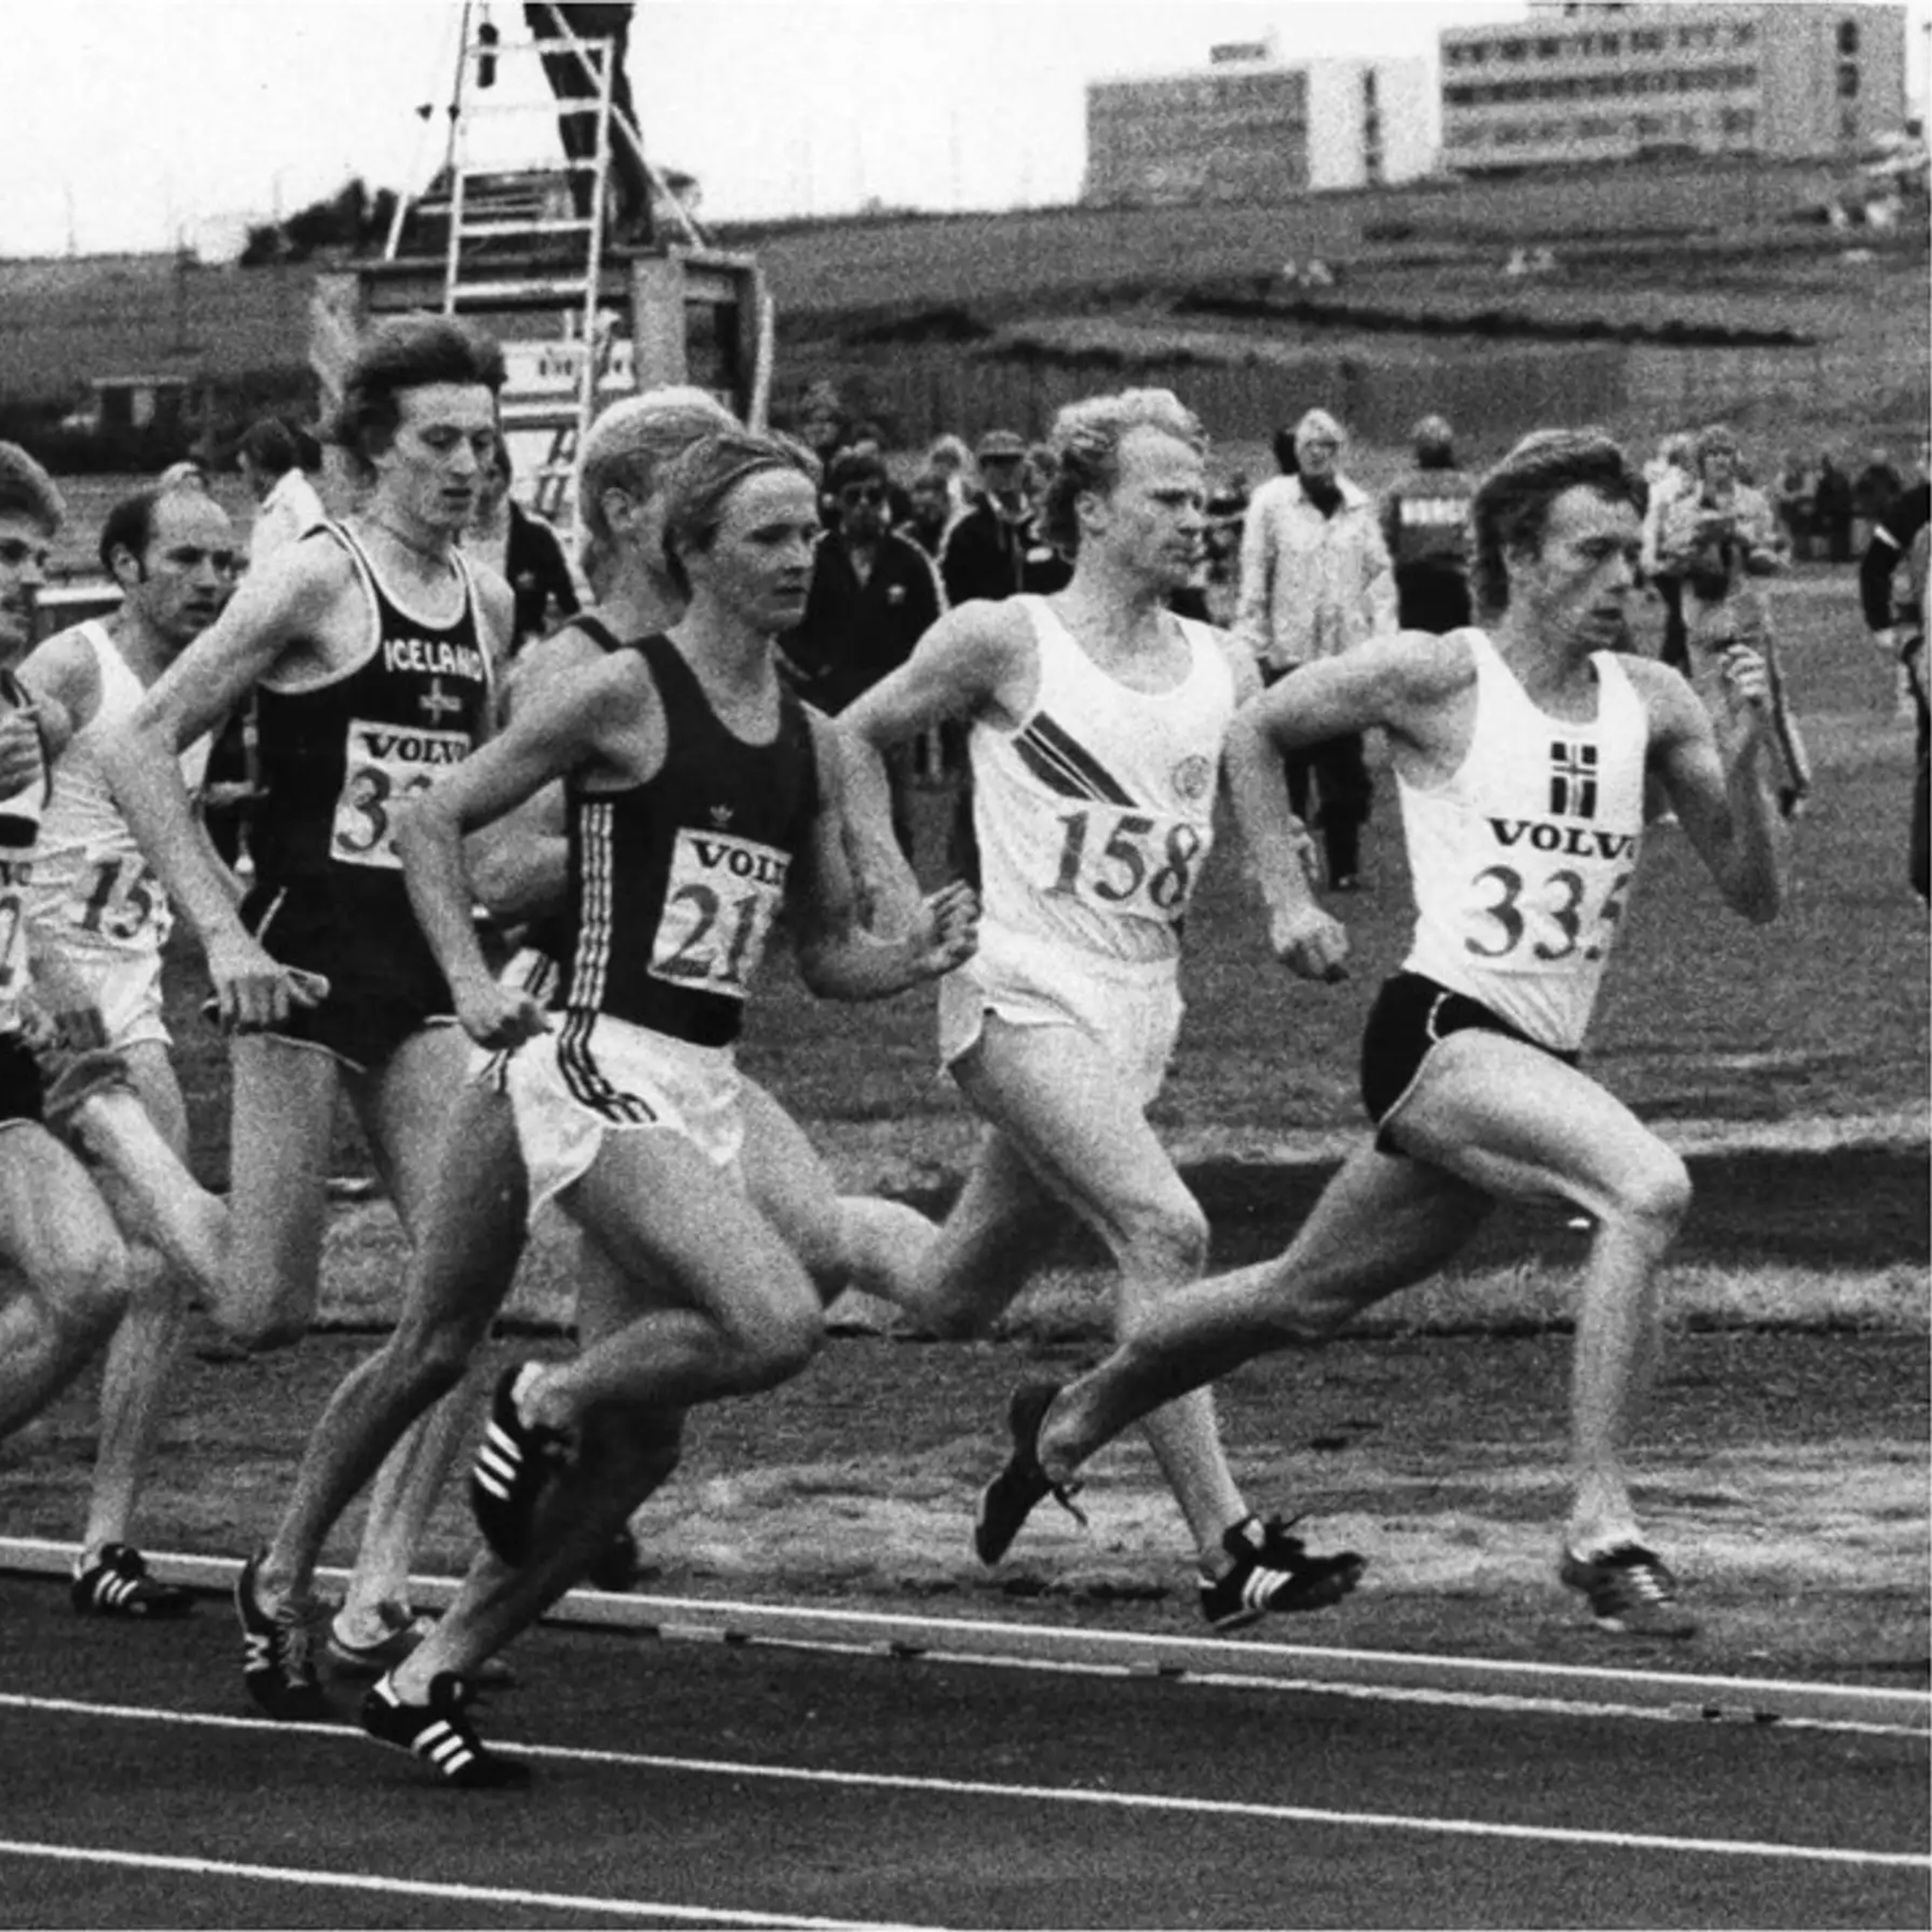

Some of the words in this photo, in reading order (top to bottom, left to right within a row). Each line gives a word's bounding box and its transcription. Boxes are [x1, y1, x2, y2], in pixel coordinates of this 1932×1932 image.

[384, 638, 482, 682] ICELAND
[359, 732, 468, 764] VOLV
[1043, 811, 1199, 909] 158
